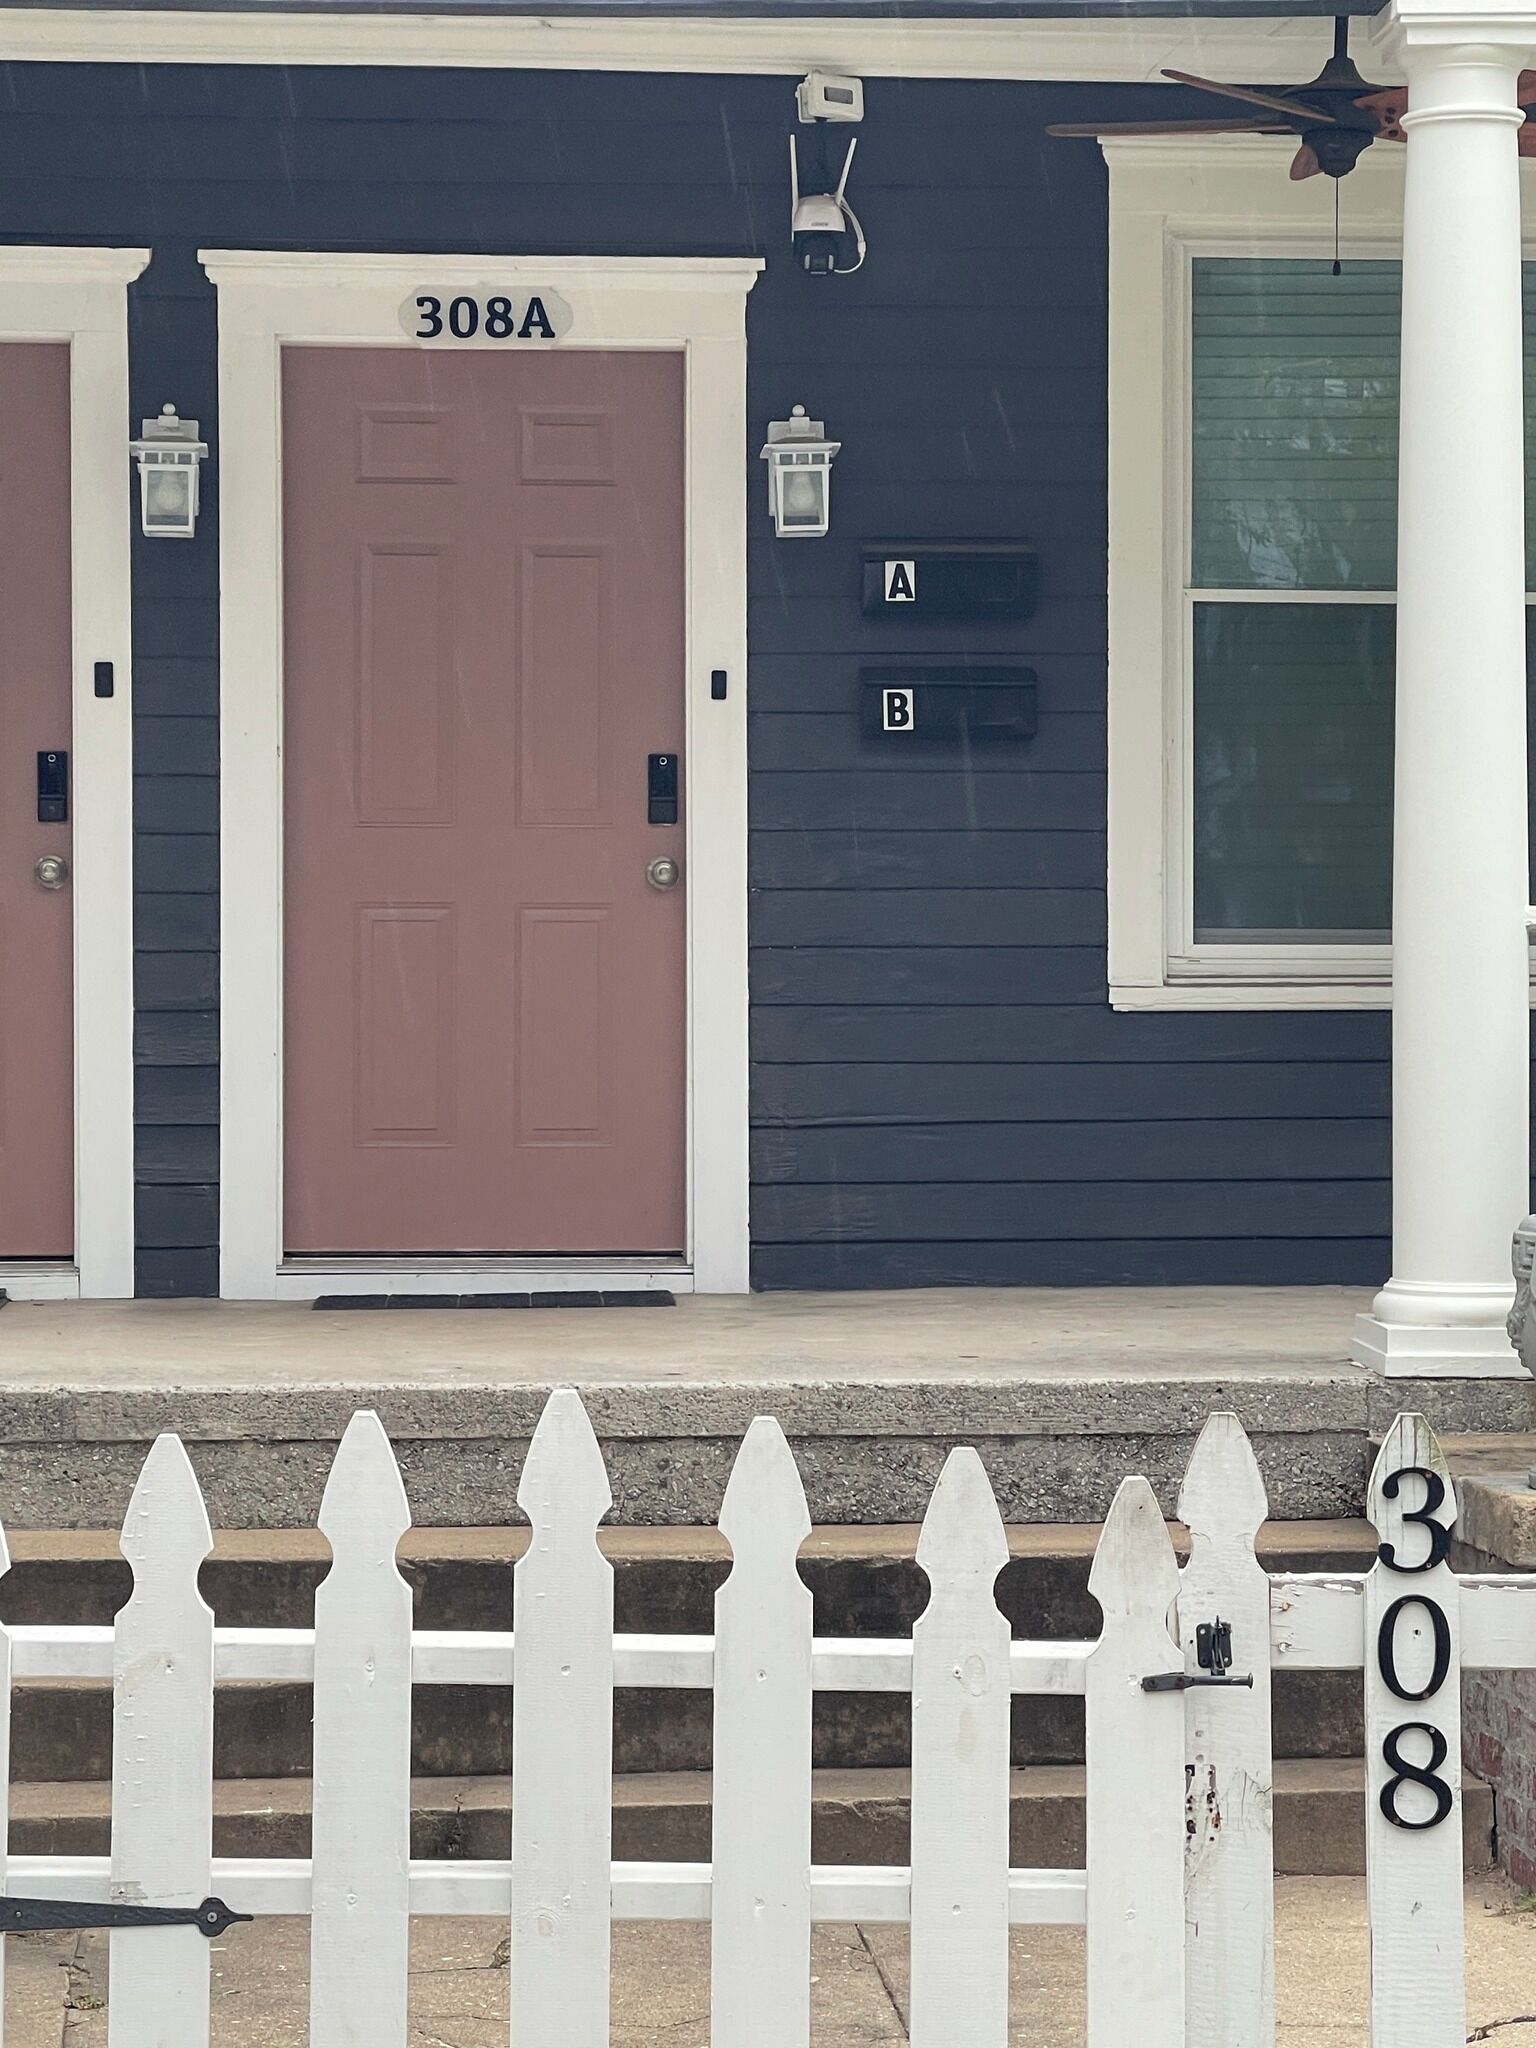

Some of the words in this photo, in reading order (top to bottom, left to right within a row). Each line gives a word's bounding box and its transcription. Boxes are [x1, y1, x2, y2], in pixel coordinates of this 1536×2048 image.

[415, 296, 556, 338] 308A
[888, 563, 914, 599] A
[887, 692, 910, 728] B
[1378, 1466, 1453, 1831] 308
